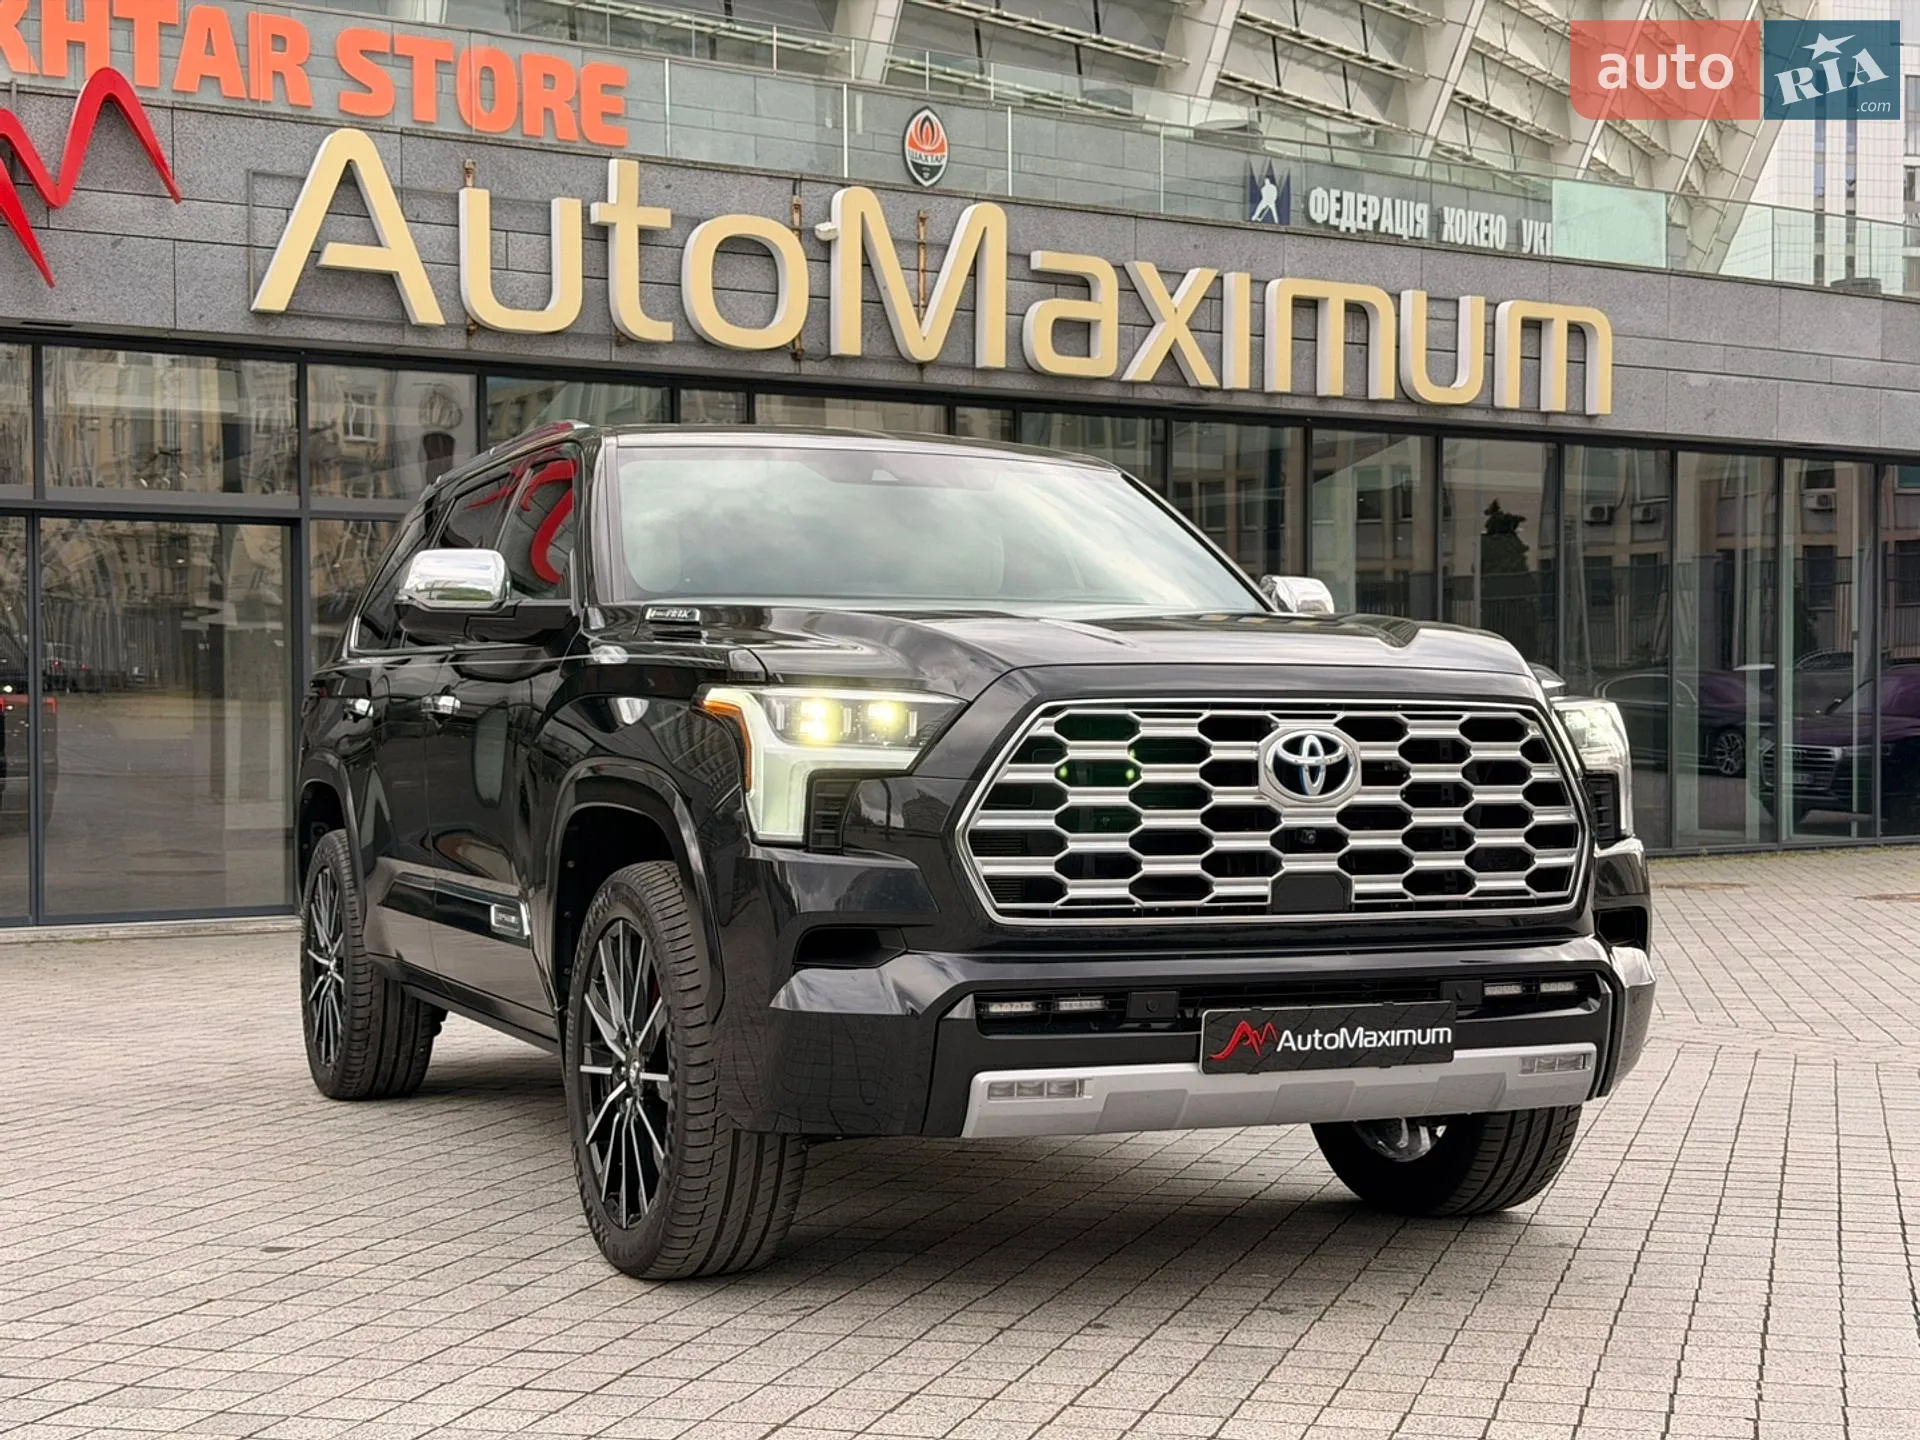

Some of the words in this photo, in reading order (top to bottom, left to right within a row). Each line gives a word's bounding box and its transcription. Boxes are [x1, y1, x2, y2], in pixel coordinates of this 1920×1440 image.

[336, 27, 629, 148] STORE
[1309, 186, 1429, 241] ФЕДЕРАЦІЯ
[1442, 205, 1508, 250] ХОКЕЮ
[250, 128, 1613, 417] AutoMaximum
[1276, 1026, 1452, 1052] AutoMaximum
